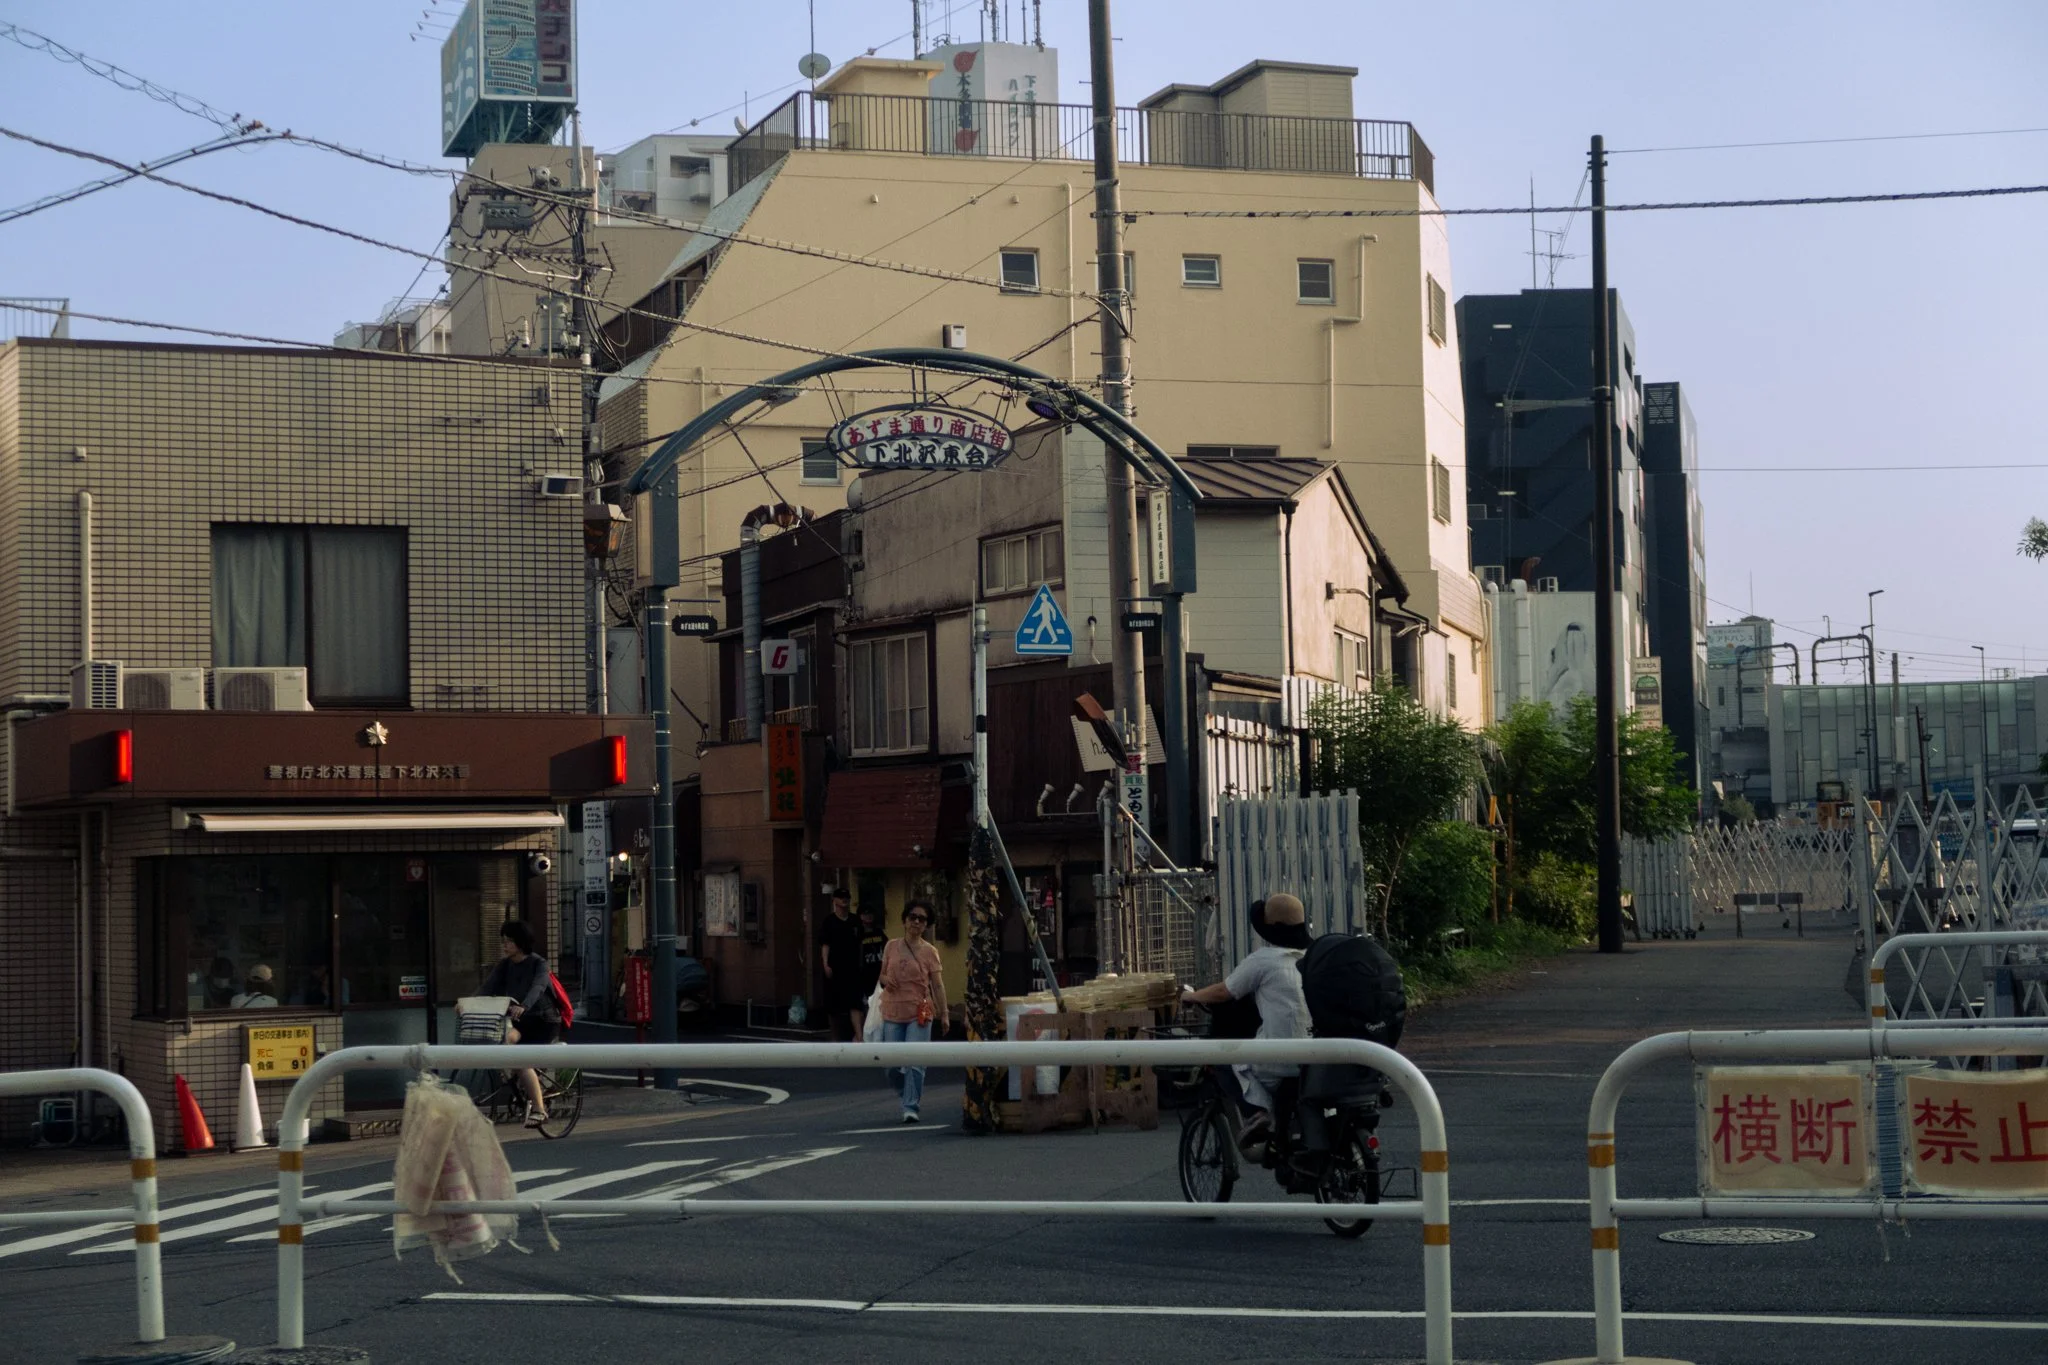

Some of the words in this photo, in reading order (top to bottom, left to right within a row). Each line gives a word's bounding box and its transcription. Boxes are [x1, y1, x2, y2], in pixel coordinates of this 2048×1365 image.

[846, 415, 1008, 450] あずま通り商店街
[869, 443, 986, 465] 下北沢東会
[771, 645, 789, 670] G
[269, 764, 470, 779] 警視庁北沢警察署下北沢交番
[1840, 807, 1855, 817] CAT
[408, 986, 426, 994] AED
[257, 1048, 274, 1058] 死亡
[1713, 1094, 1857, 1165] 横断
[1913, 1097, 2048, 1165] 禁止
